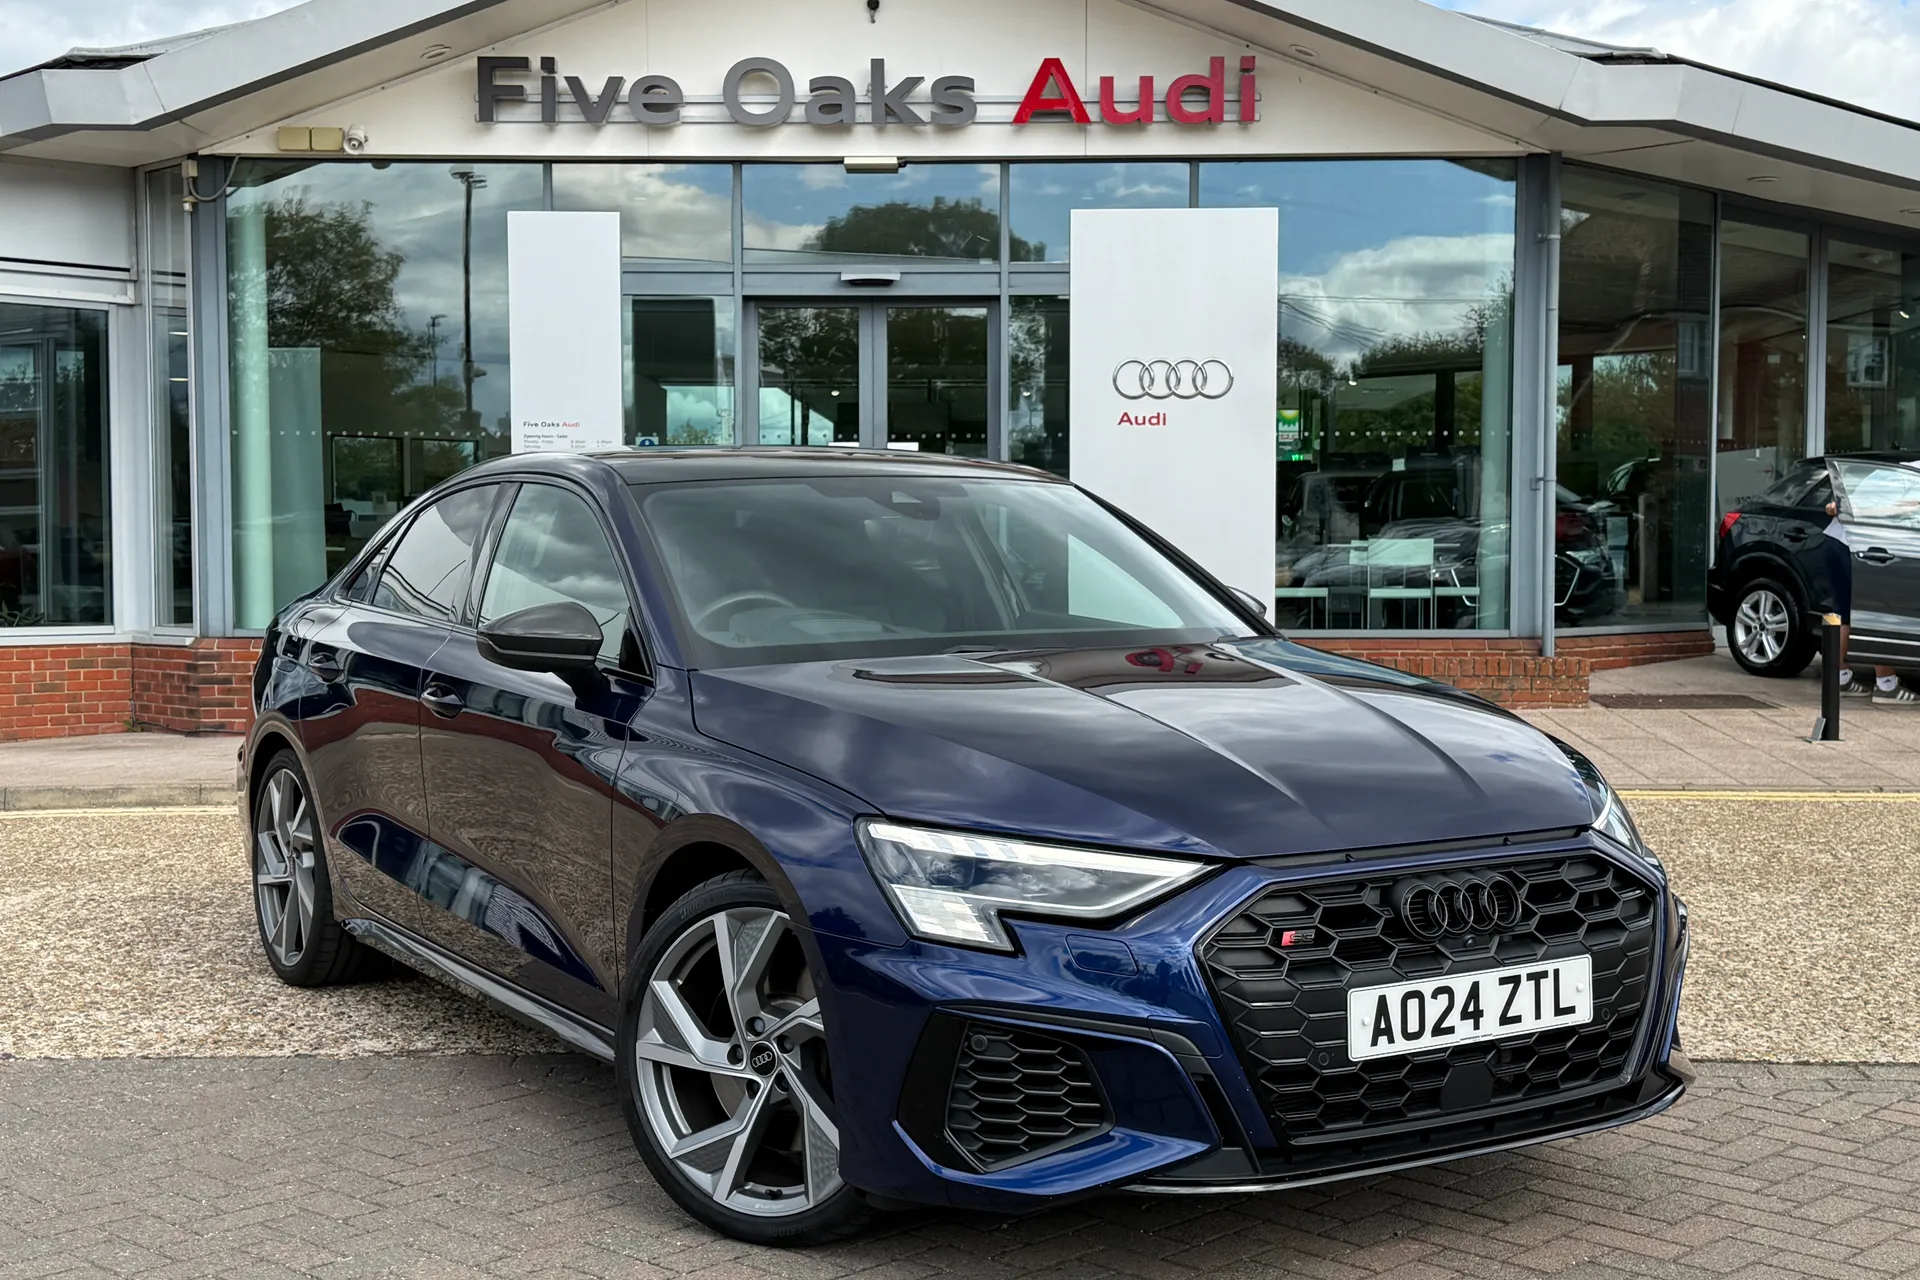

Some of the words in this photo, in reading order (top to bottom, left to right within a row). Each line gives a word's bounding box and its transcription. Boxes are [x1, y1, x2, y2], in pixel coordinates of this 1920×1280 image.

[477, 56, 684, 125] Five
[723, 57, 977, 126] Oaks
[1011, 55, 1256, 126] Audi
[1117, 411, 1166, 426] Audi
[1370, 981, 1484, 1047] AO24
[1498, 968, 1576, 1027] ZTL
